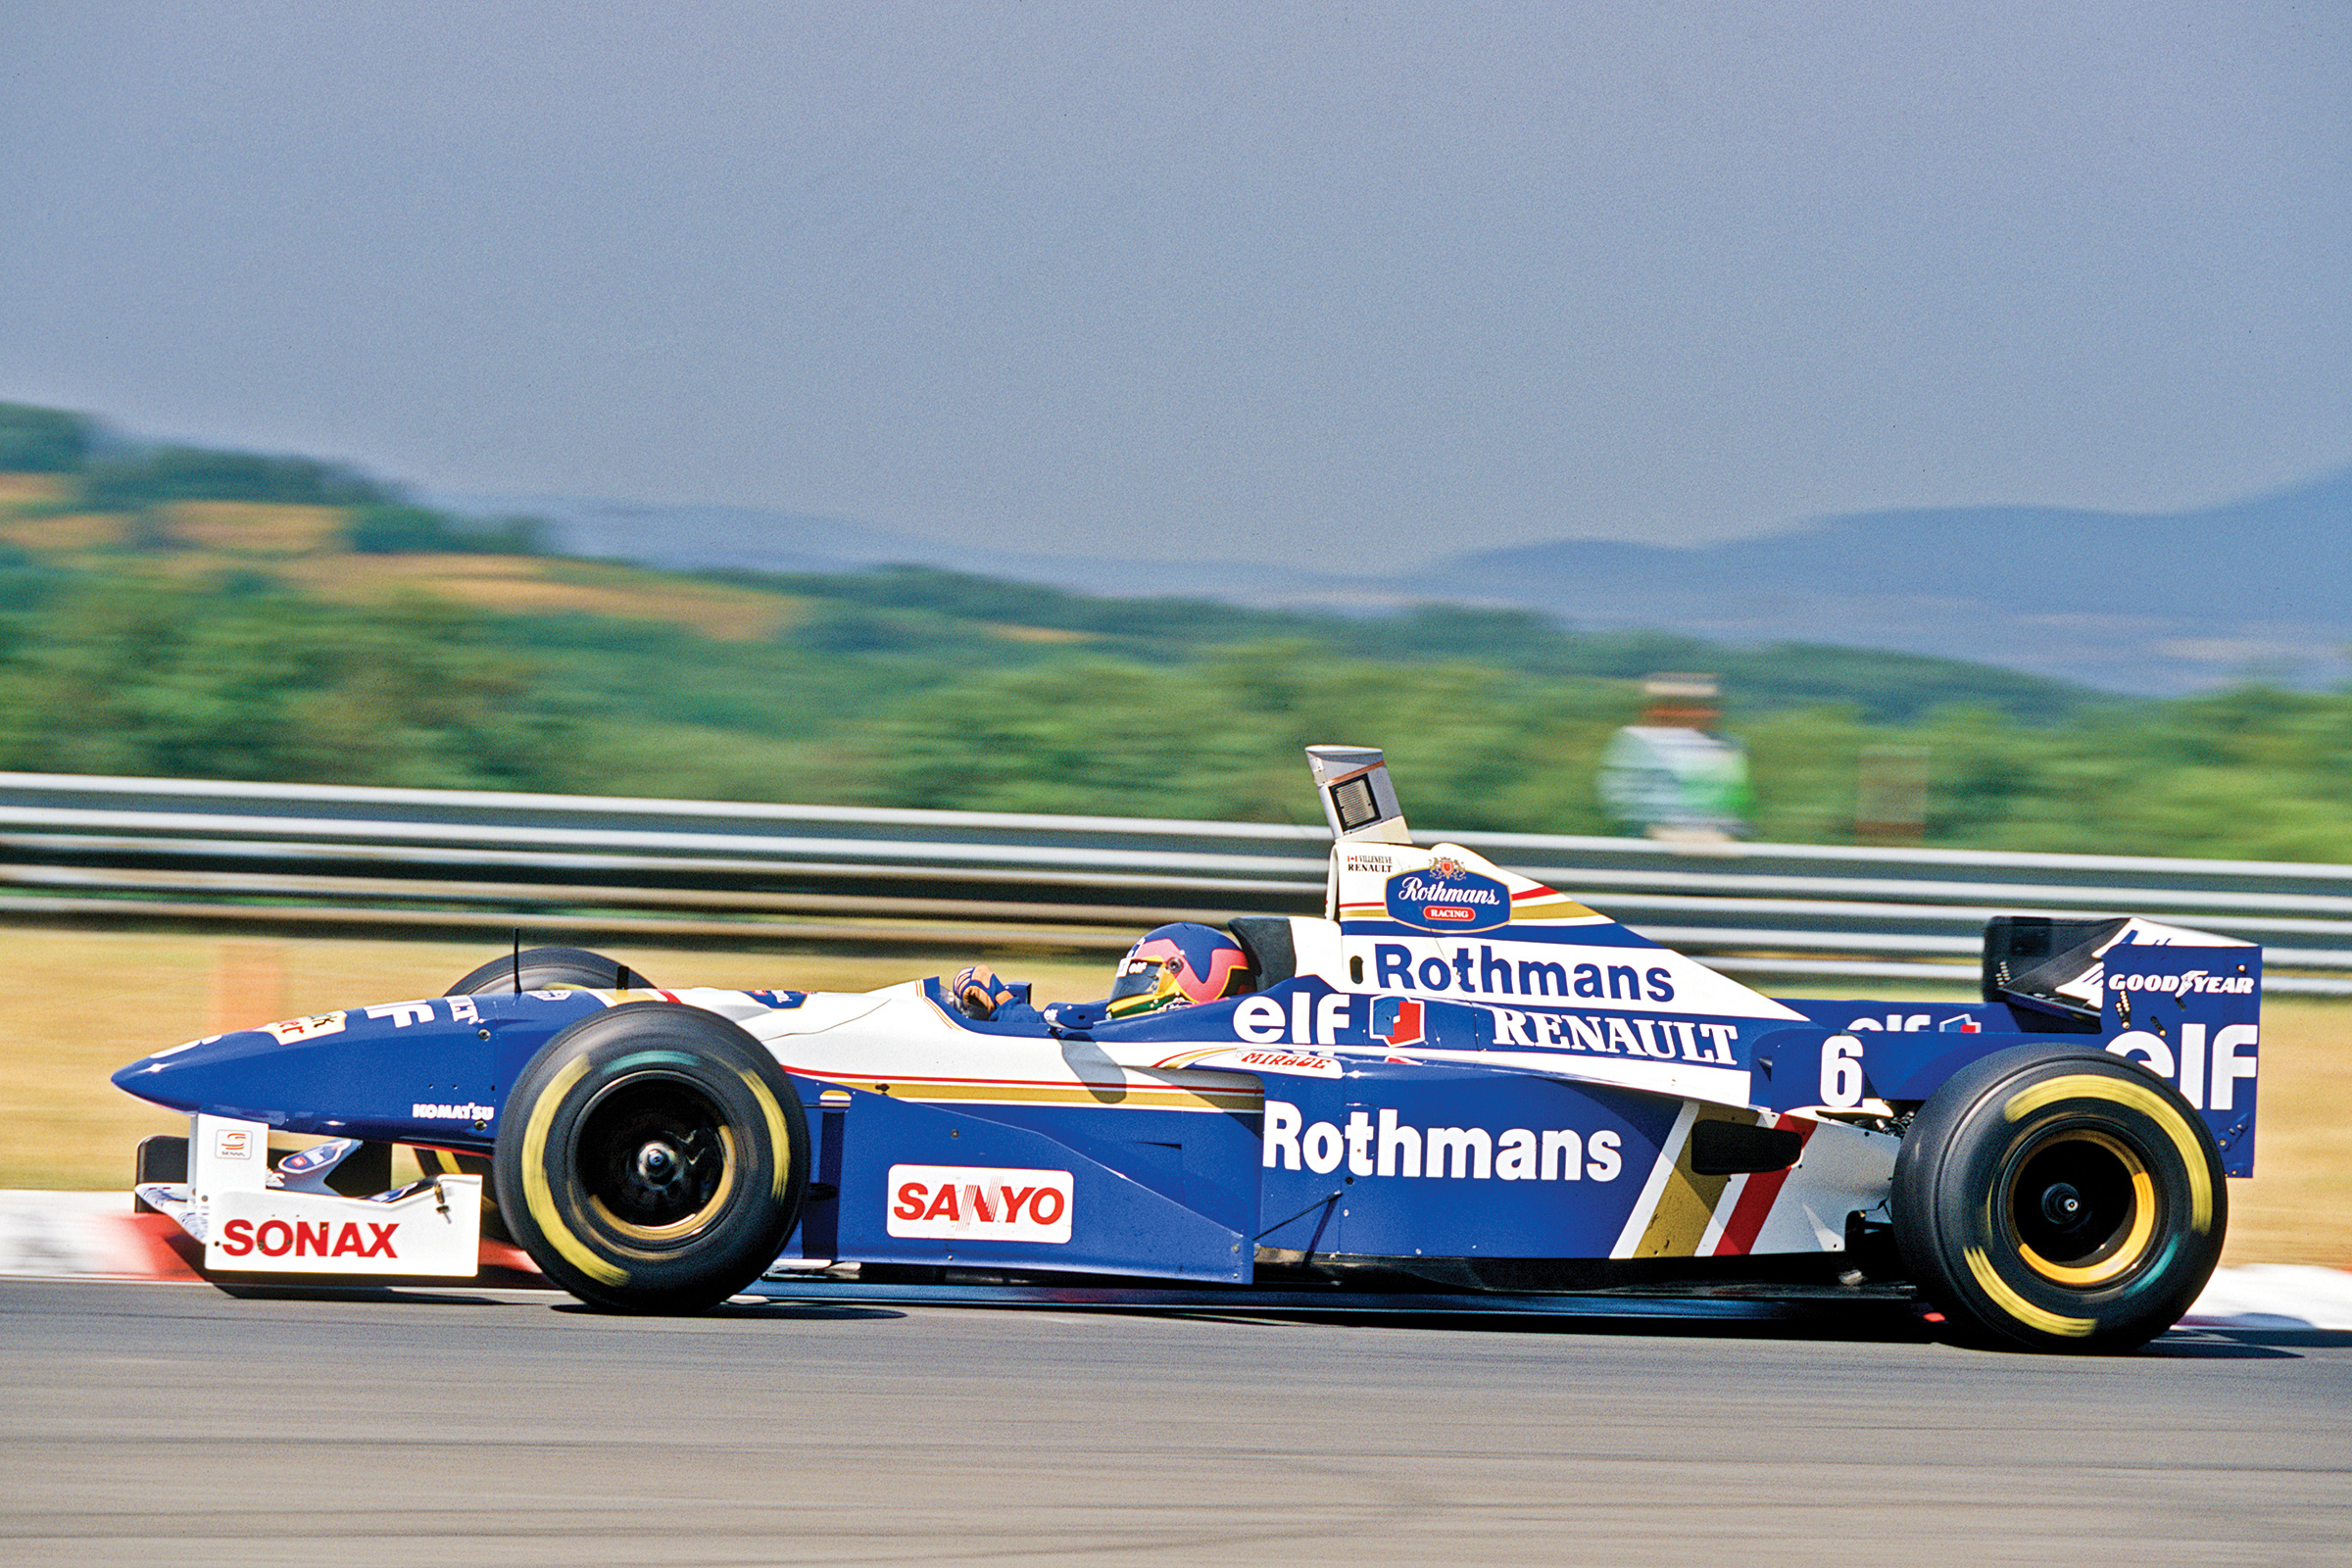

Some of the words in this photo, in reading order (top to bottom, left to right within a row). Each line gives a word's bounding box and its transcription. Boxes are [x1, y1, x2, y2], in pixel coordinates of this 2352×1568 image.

[1348, 863, 1393, 873] RENAULT
[1398, 877, 1500, 906] Rothmans
[1431, 909, 1468, 919] RACING
[1374, 943, 1675, 1003] Rothmans
[2108, 970, 2254, 998] GOODYEAR
[1233, 992, 1350, 1045] elf
[1491, 1006, 1739, 1065] RENAULT
[1820, 1035, 1864, 1107] 6
[1262, 1100, 1622, 1183] Rothmans
[893, 1177, 1065, 1229] SANYO
[221, 1218, 401, 1258] SONAX
